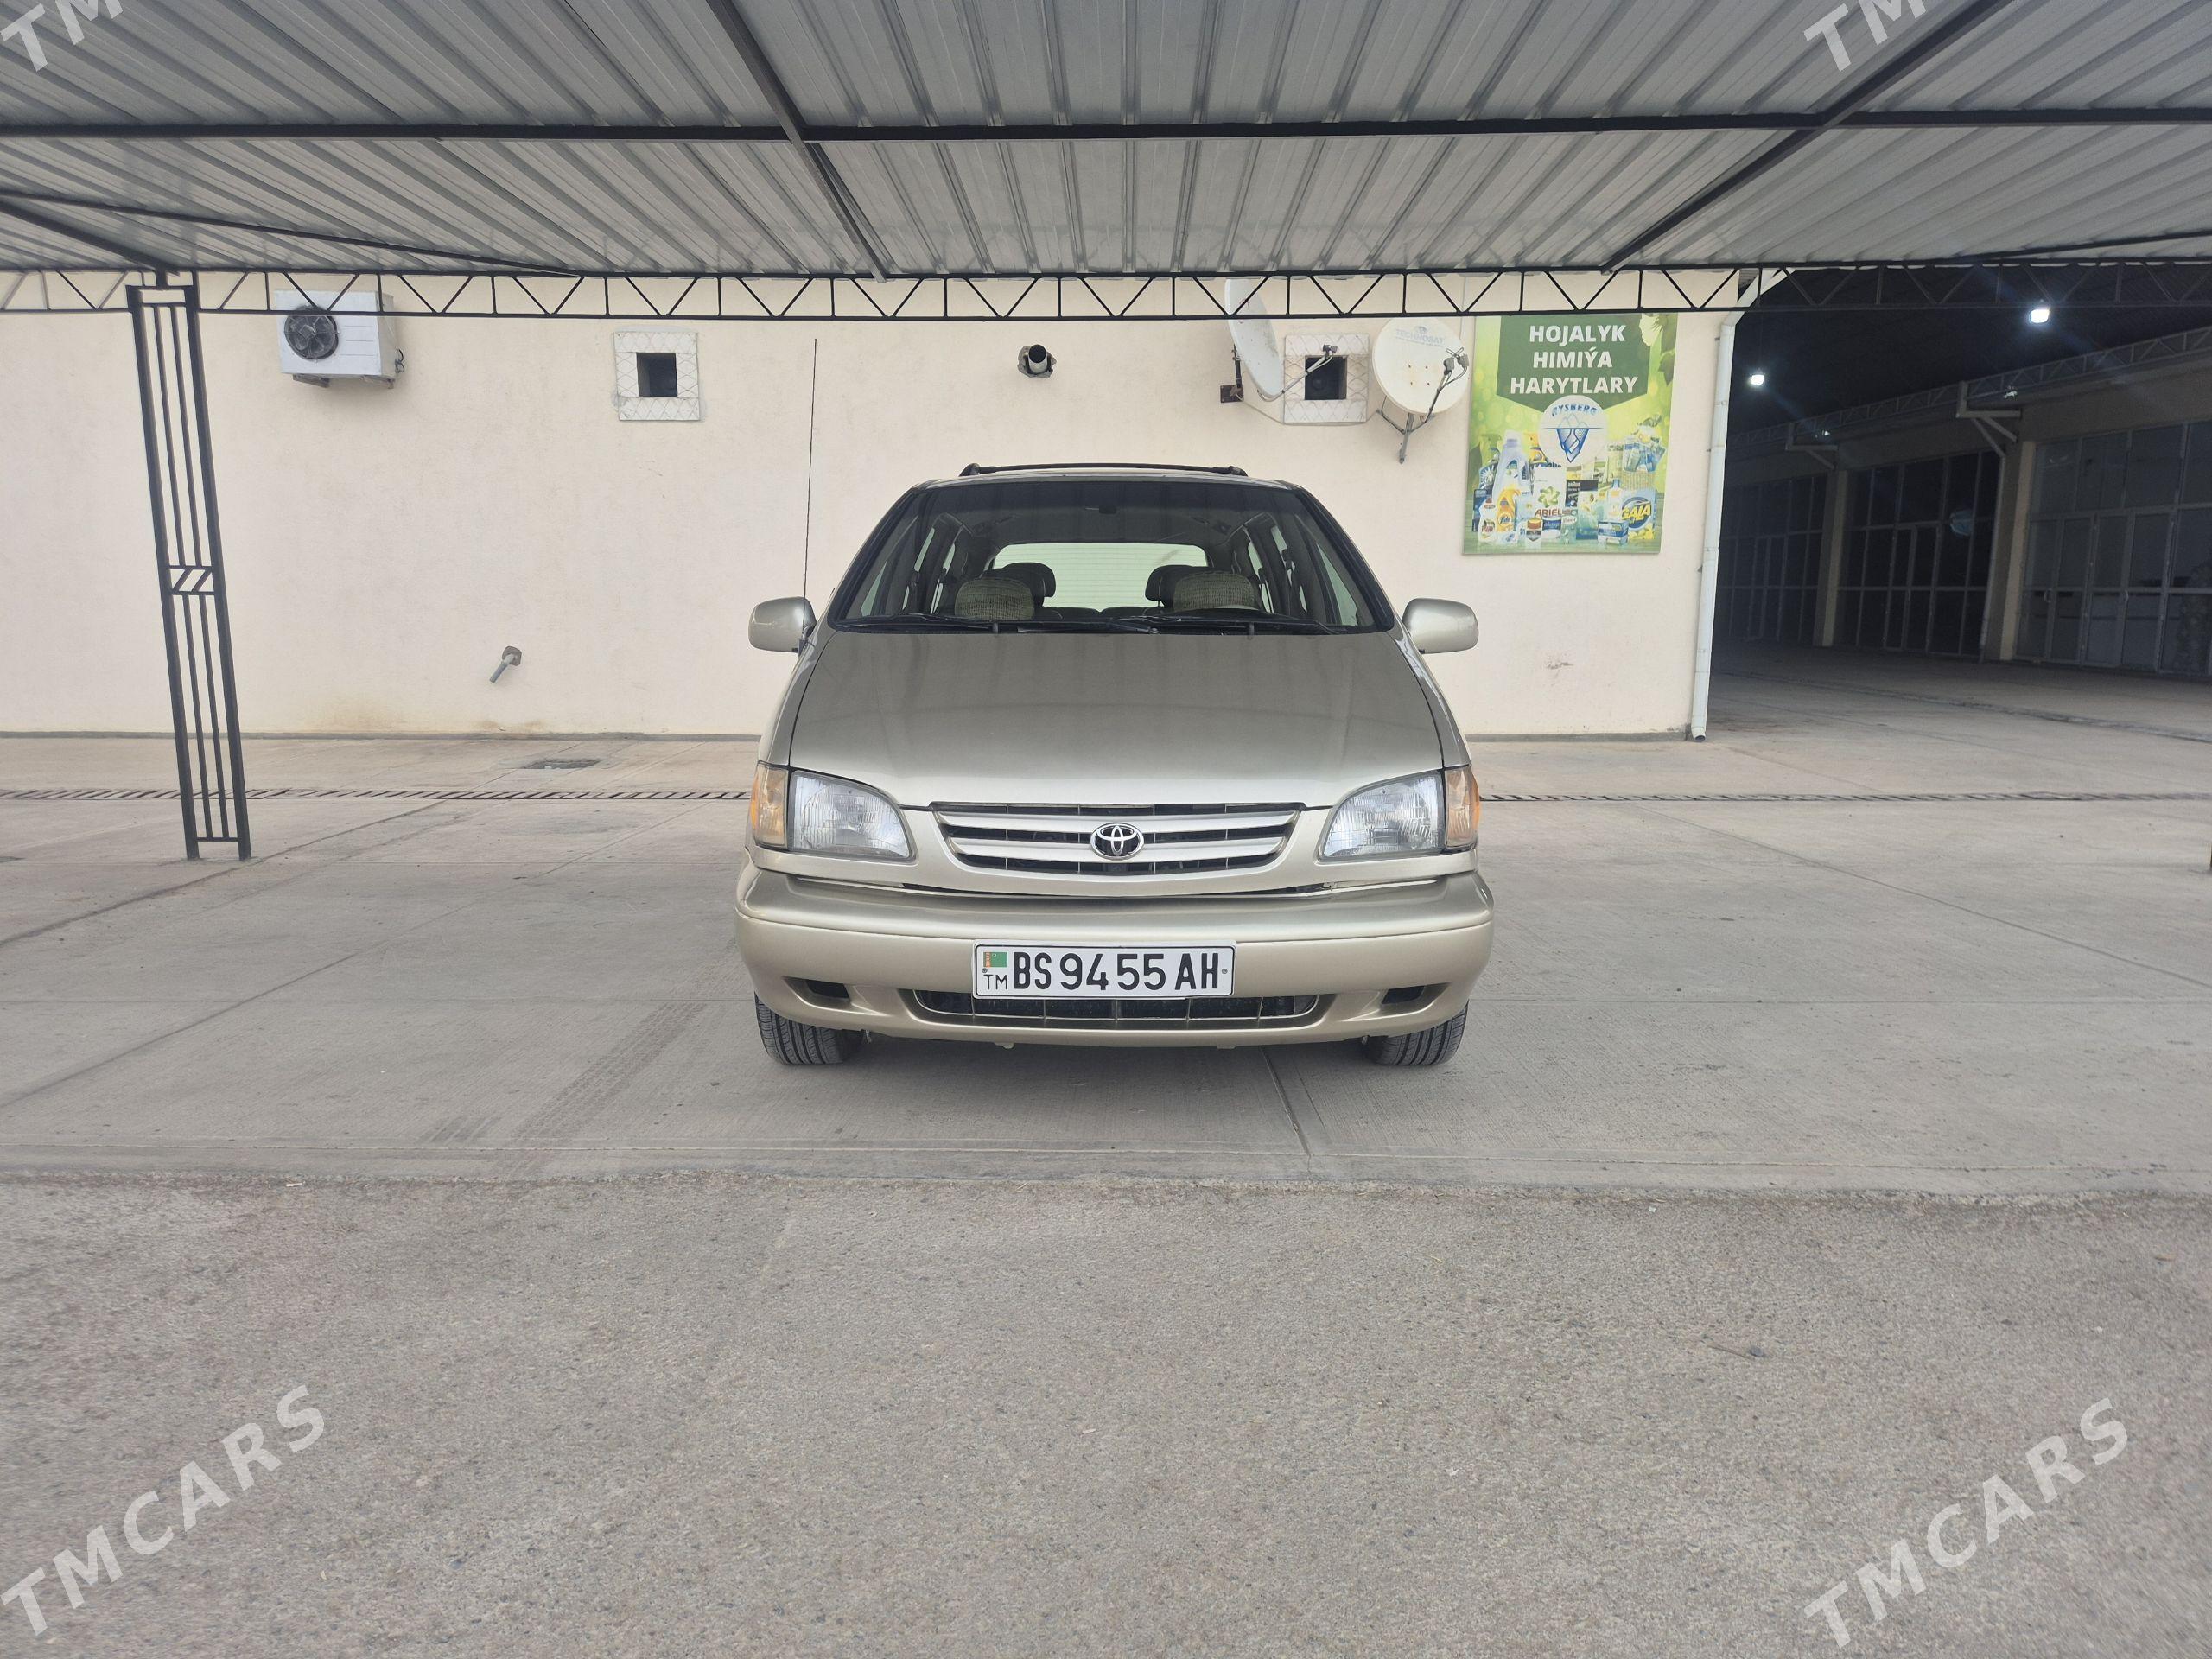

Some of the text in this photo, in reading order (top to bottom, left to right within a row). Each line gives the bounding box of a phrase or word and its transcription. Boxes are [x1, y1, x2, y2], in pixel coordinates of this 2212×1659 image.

[1529, 325, 1626, 346] HOJALYK
[1533, 347, 1613, 368] HIMIÝA
[1510, 377, 1638, 394] HARYTLARY
[1535, 508, 1562, 517] ARIEL
[983, 974, 1008, 990] TM
